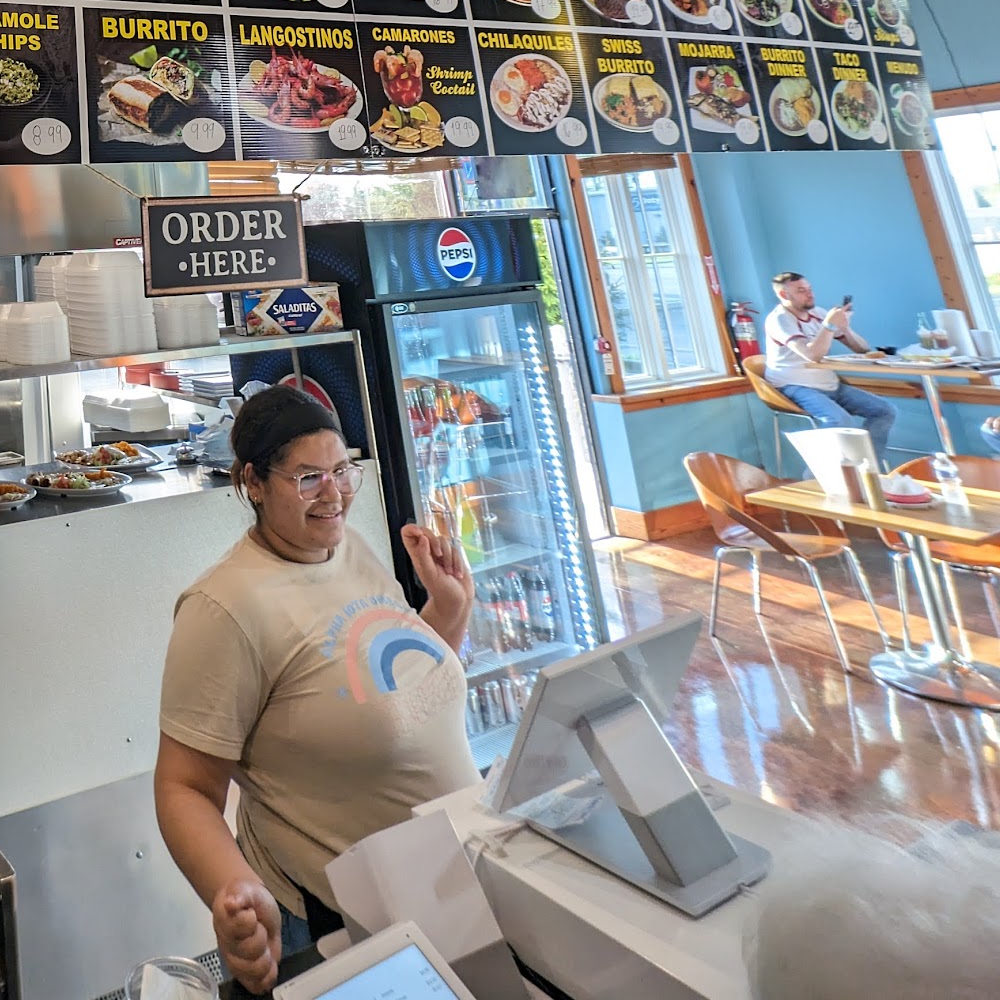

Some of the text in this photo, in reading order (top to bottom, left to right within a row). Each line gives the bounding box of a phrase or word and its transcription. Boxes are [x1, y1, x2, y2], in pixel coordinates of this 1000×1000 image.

[102, 17, 209, 42] BURRITO
[239, 24, 354, 49] LANGOSTINOS
[372, 27, 456, 44] CAMARONES
[478, 32, 574, 52] CHILAQUILES
[602, 39, 642, 55] SWISS
[678, 43, 735, 60] MOJARRA
[760, 47, 806, 64] BURRITO
[833, 52, 861, 67] TACO
[597, 57, 655, 75] BURRITO
[768, 62, 807, 78] DINNER
[832, 66, 869, 82] DINNER
[426, 65, 473, 87] Shrimp
[430, 81, 476, 96] Coctail
[32, 123, 63, 146] 8.99
[190, 121, 215, 141] 9.99
[162, 209, 287, 246] ORDER
[115, 237, 142, 246] CAPTIVE
[441, 248, 473, 260] PEPSI
[272, 302, 317, 315] SALADITAS
